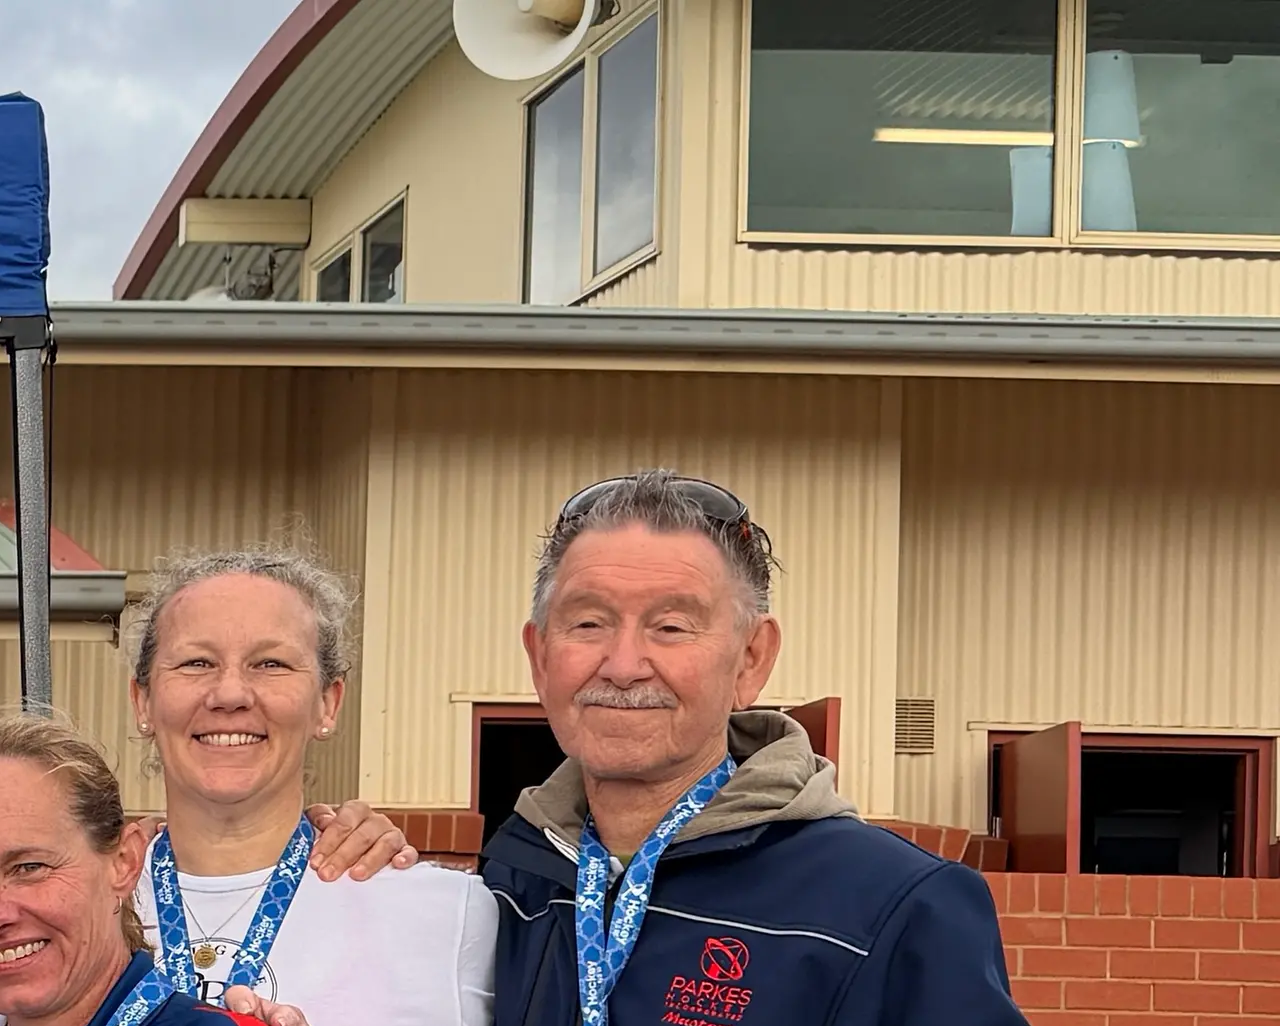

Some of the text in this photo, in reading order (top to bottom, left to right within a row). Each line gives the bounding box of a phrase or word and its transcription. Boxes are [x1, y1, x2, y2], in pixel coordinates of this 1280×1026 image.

[583, 856, 601, 895] Hockey
[247, 915, 273, 953] Hockey
[615, 899, 641, 946] Hockey
[586, 960, 598, 1006] Hockey
[670, 976, 753, 1006] PARKES
[665, 992, 746, 1013] HOCKEY
